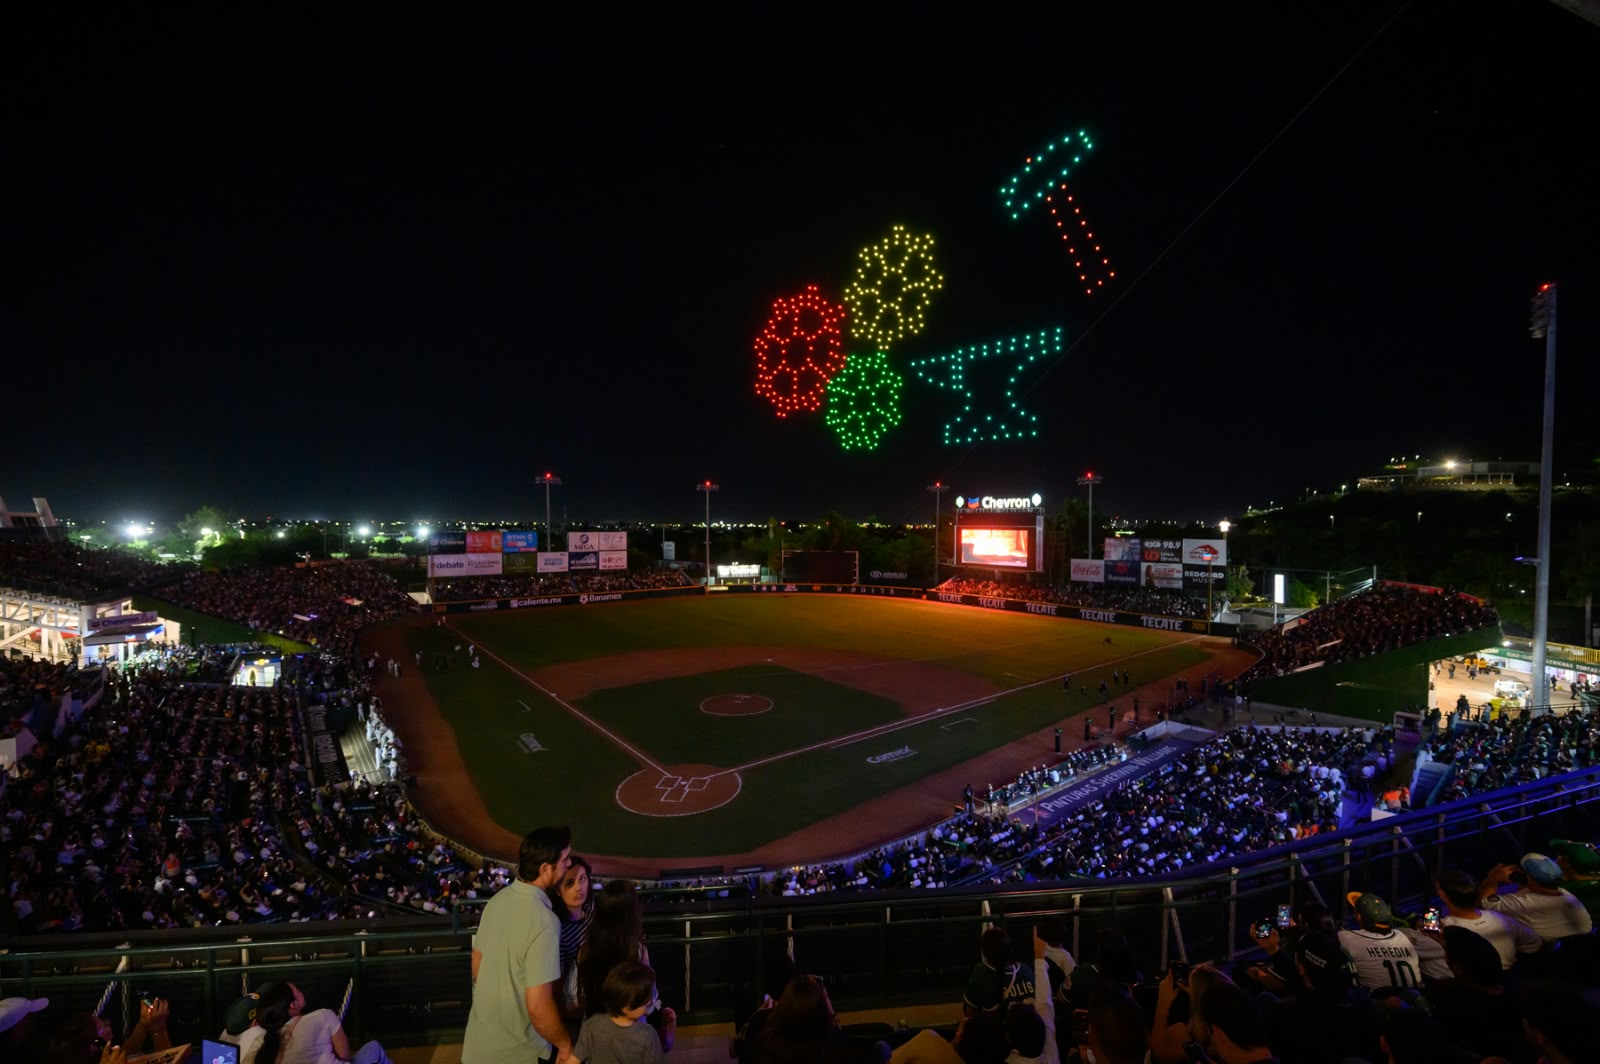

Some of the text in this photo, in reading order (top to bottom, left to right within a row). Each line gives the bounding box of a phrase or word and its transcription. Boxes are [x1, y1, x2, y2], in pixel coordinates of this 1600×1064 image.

[981, 496, 1031, 508] Chevron
[1163, 541, 1181, 549] 98.9
[436, 561, 464, 569] debate
[1072, 564, 1102, 577] Coca-Cola
[1107, 574, 1136, 582] Banamex
[518, 597, 562, 607] caliente.mx
[589, 593, 622, 601] Banamex
[938, 593, 963, 603] TECATE
[978, 597, 1006, 609] TECATE
[1025, 603, 1058, 615] TECATE
[1079, 608, 1116, 623] TECATE
[102, 617, 139, 627] Chevron
[1140, 615, 1184, 631] TECATE
[866, 745, 913, 764] Comex
[1040, 784, 1099, 813] PINTURAS
[1366, 946, 1413, 958] HEREDIA
[1382, 960, 1418, 989] 10
